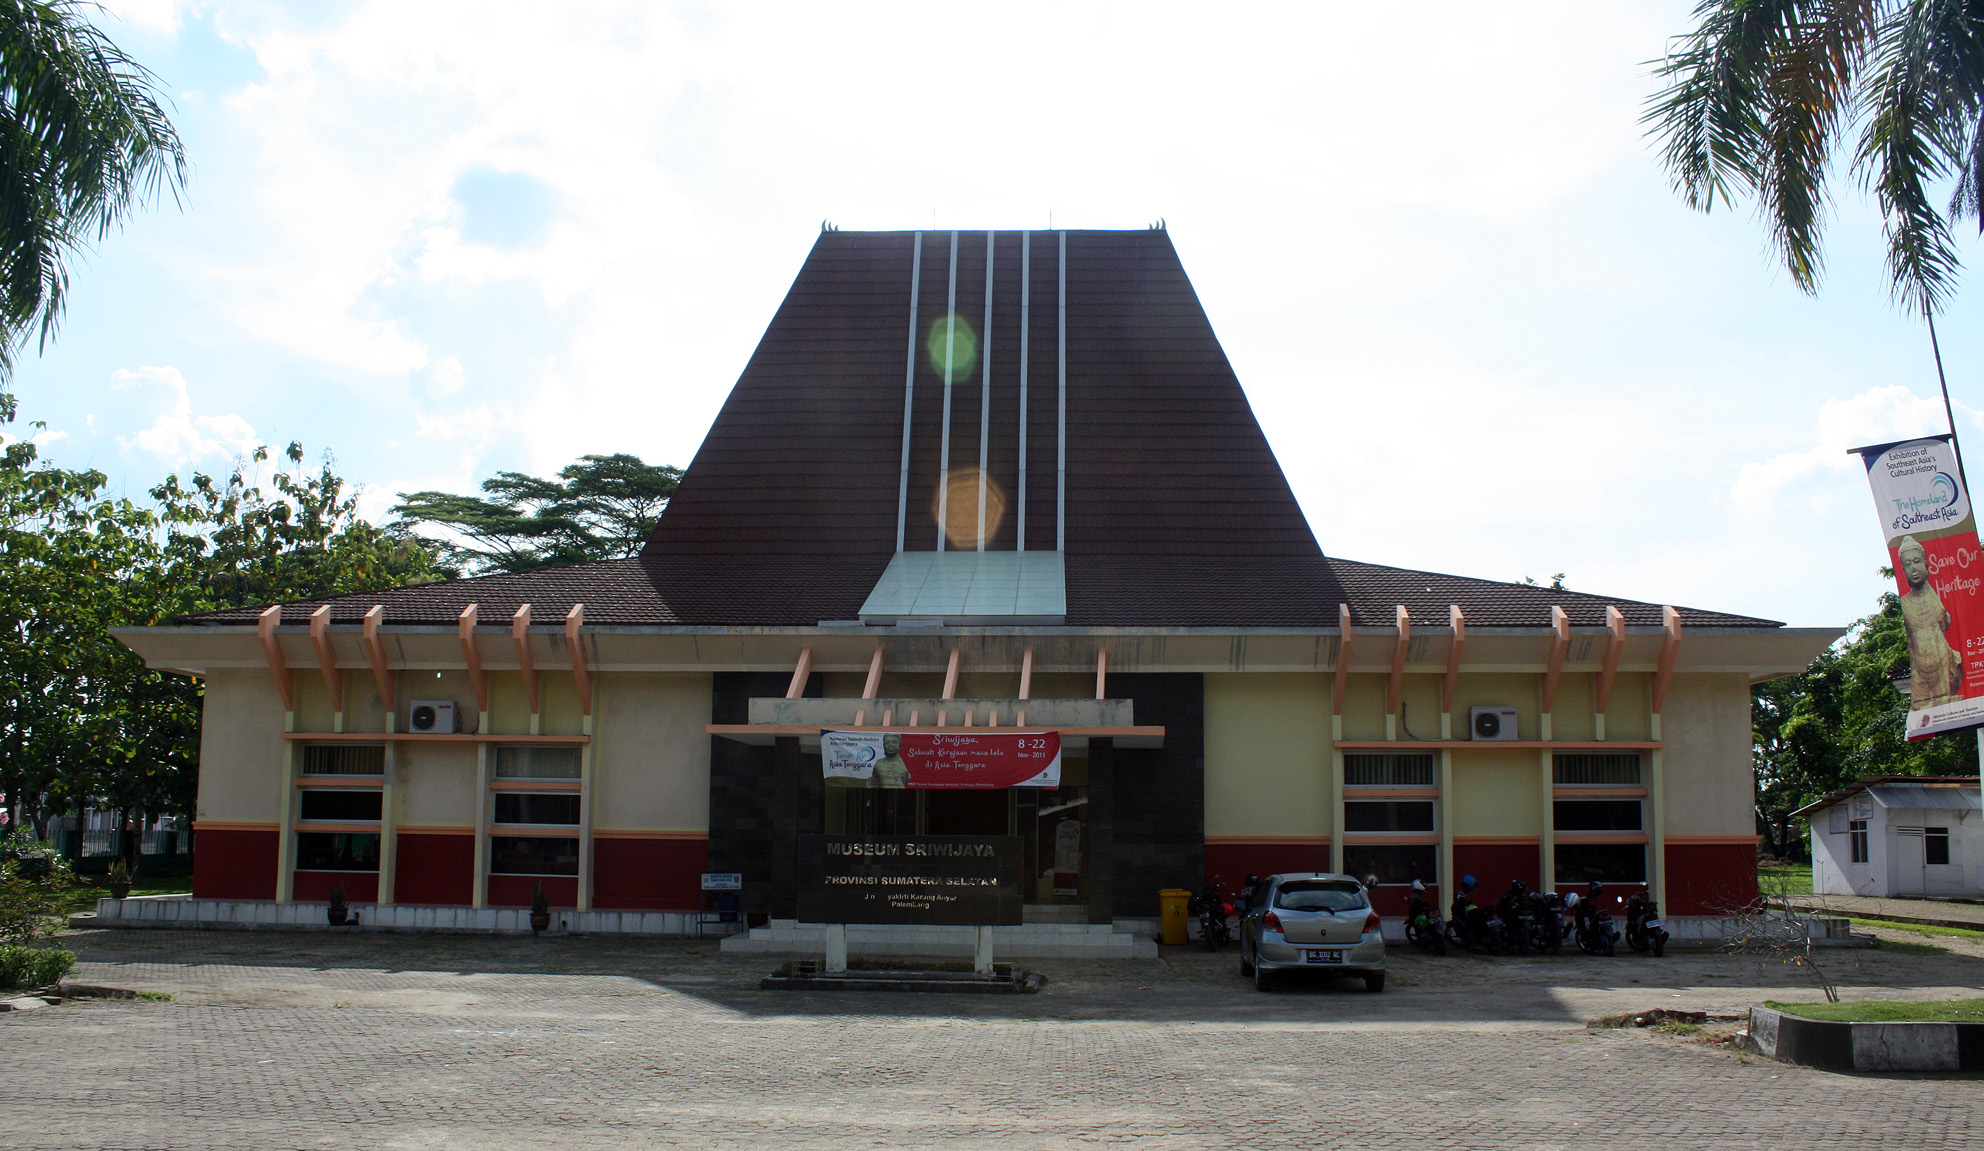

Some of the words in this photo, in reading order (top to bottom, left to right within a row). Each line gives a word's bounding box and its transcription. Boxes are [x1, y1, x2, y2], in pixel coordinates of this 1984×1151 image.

[1888, 450, 1920, 460] Exhibition
[1920, 447, 1927, 455] of
[1886, 458, 1917, 470] Southeast
[1919, 455, 1936, 463] Asia's
[1890, 467, 1915, 478] Cultural
[1915, 464, 1937, 473] History
[1908, 490, 1948, 512] Homeland
[1892, 516, 1901, 529] of
[1901, 508, 1940, 529] Southeast
[1940, 507, 1958, 522] Asia
[1928, 553, 1955, 574] Save
[1956, 547, 1978, 568] Our
[1935, 575, 1980, 599] Heritage
[907, 747, 935, 757] Sebuah
[937, 748, 968, 758] Kerajaan
[990, 748, 1004, 756] lalu
[829, 759, 842, 769] Asia
[842, 759, 872, 771] Tenggara
[934, 760, 950, 770] Asia
[952, 760, 986, 771] Tenggara
[827, 842, 900, 856] MUSEUM
[905, 843, 995, 857] SRIWIJAYA
[825, 876, 877, 885] PROVINSI
[881, 876, 943, 886] SUMATERA
[945, 877, 998, 886] SELATAN
